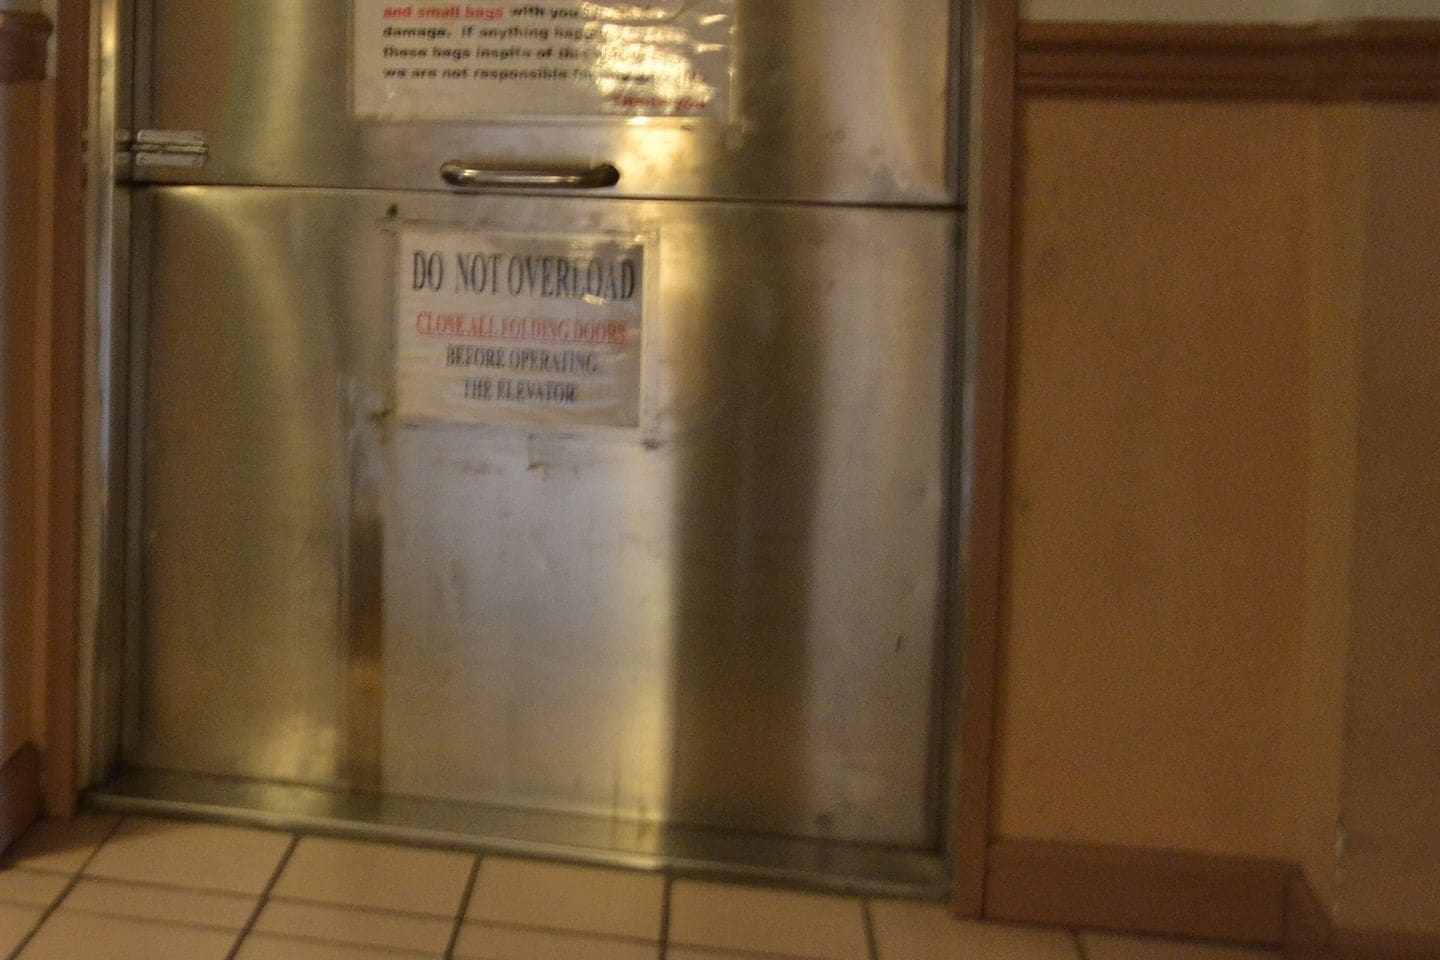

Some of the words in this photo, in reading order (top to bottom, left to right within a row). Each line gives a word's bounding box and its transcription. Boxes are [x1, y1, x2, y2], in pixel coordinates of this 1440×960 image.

[383, 6, 412, 19] and
[417, 5, 460, 19] small
[464, 5, 504, 20] bags
[511, 4, 545, 17] with
[478, 25, 549, 40] anything
[383, 45, 427, 58] these
[432, 46, 471, 61] bags
[411, 69, 437, 79] are
[441, 68, 467, 79] not
[412, 250, 444, 292] DO
[455, 251, 504, 295] NOT
[508, 255, 635, 301] OVERLOAD
[416, 310, 465, 337] CLOSE
[446, 343, 506, 368] BEFORE
[463, 376, 493, 400] THE
[495, 377, 577, 402] ELEVATOR
